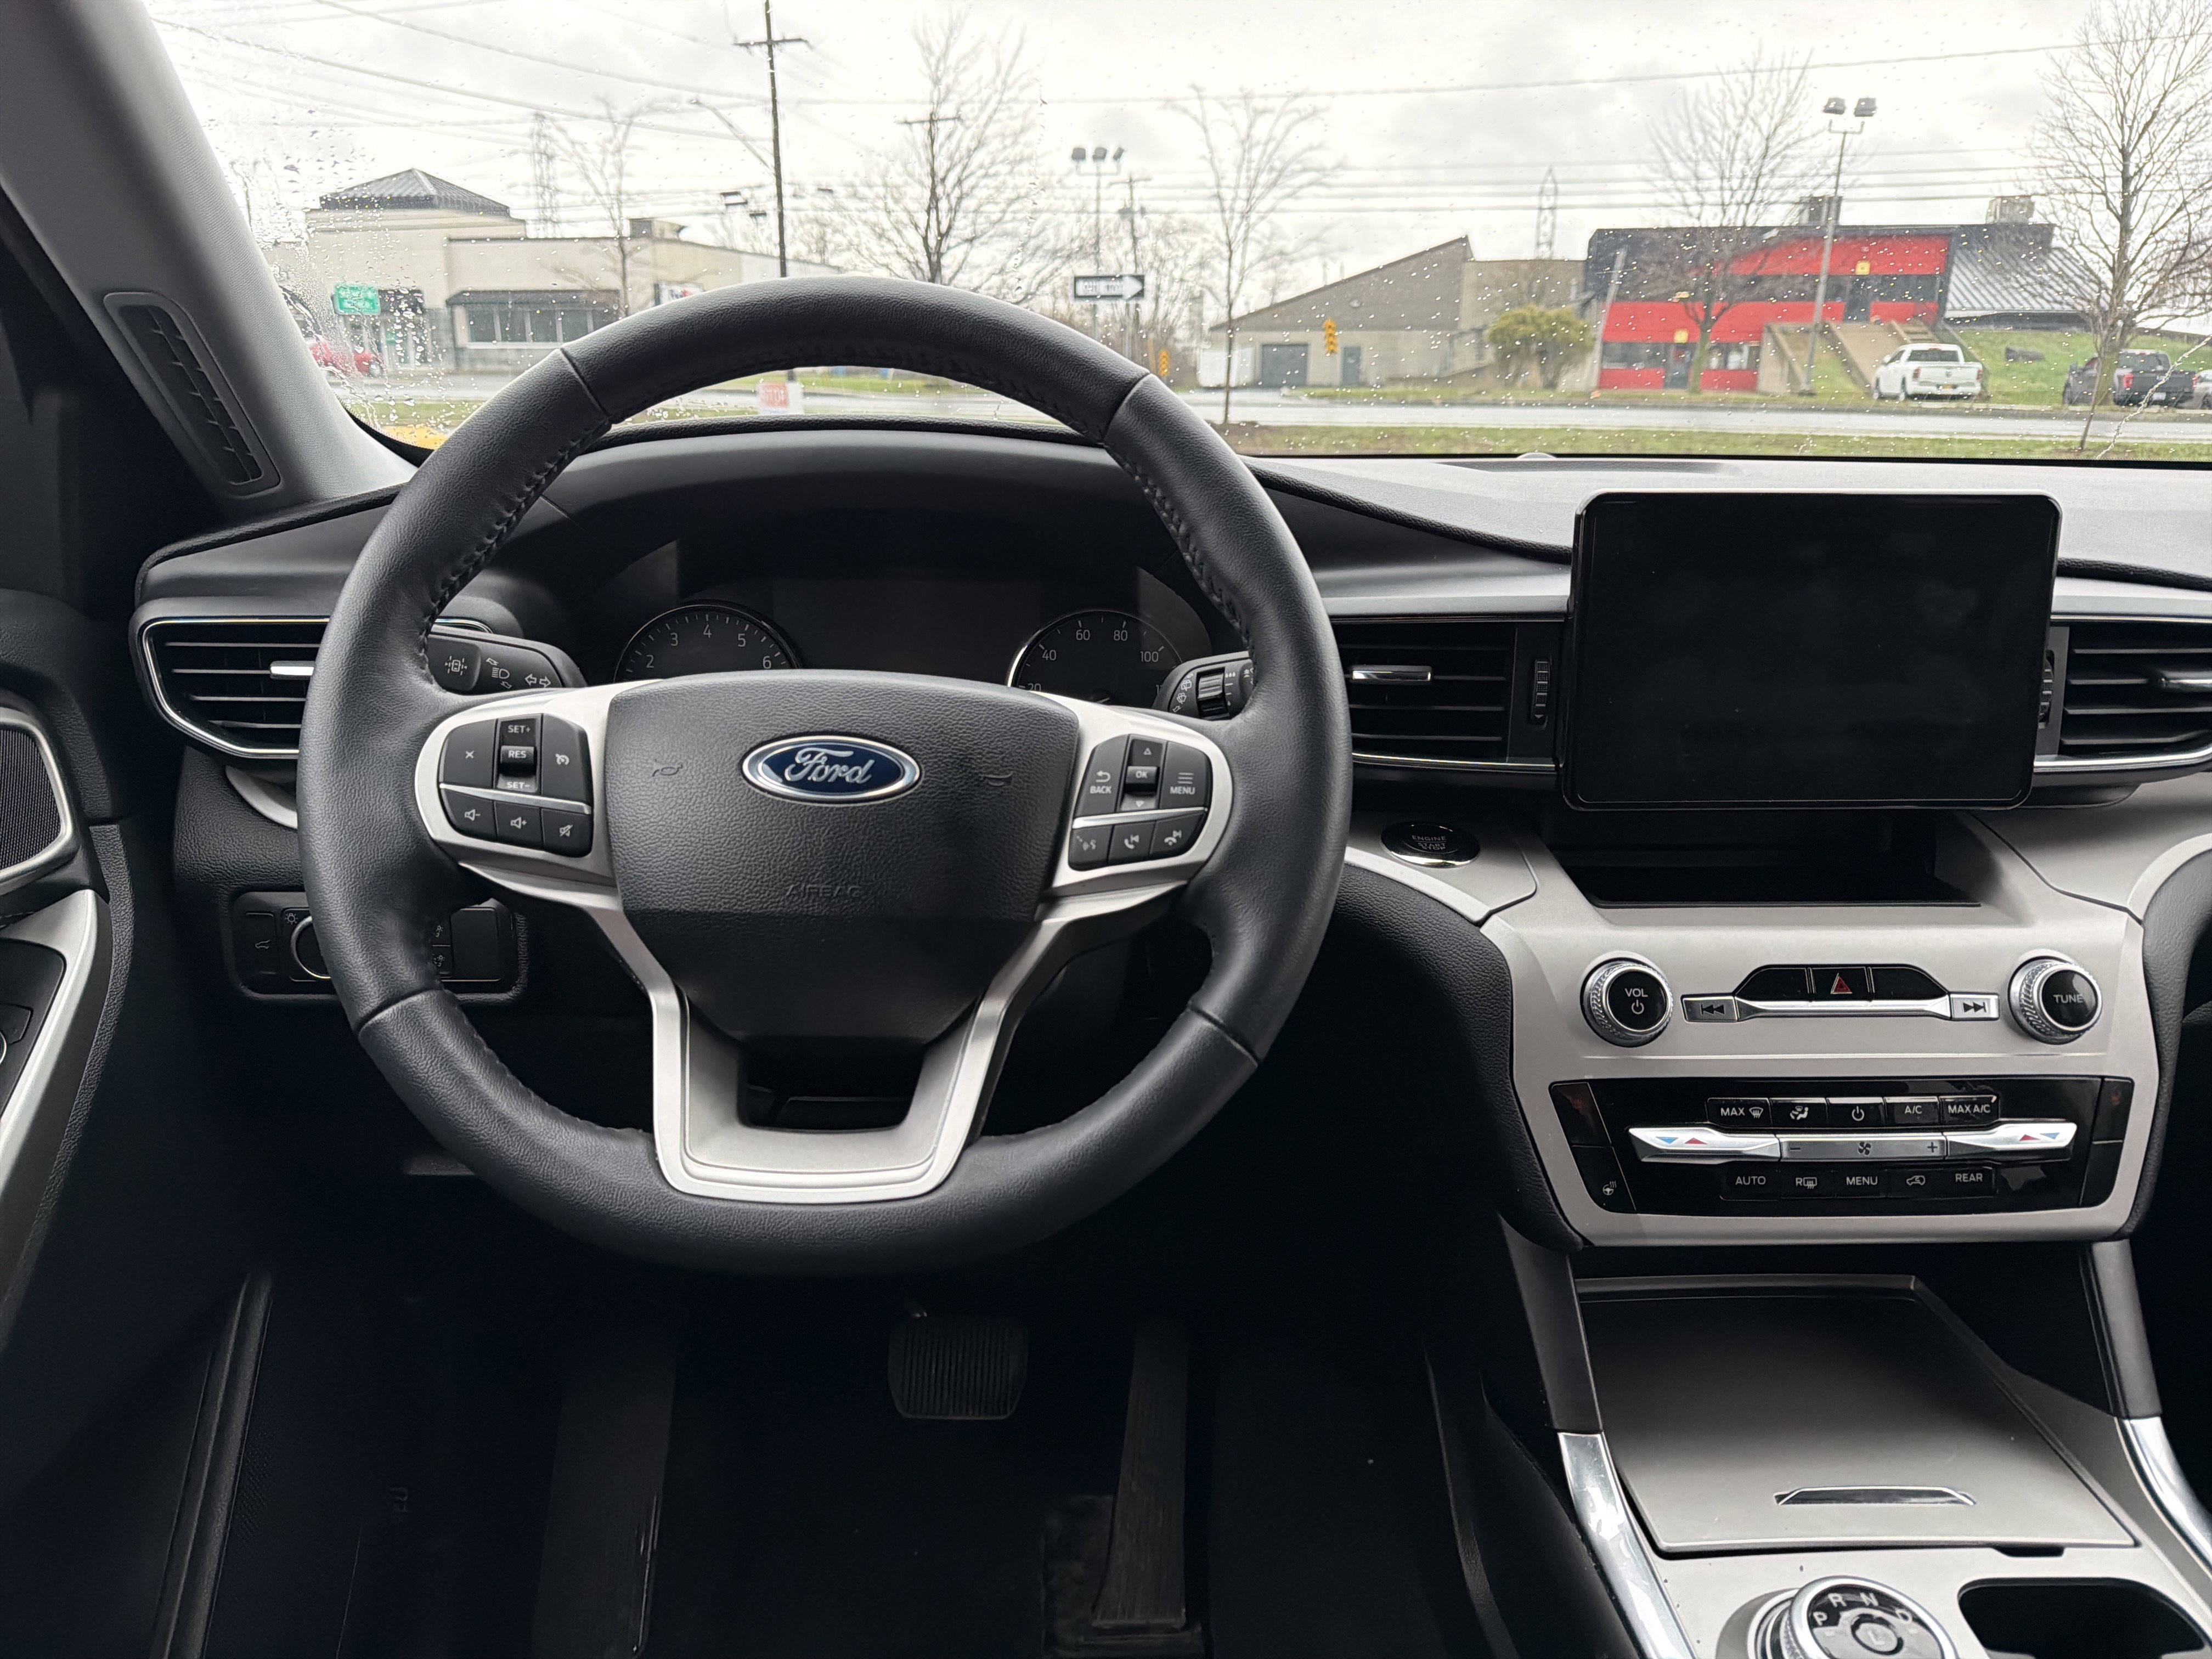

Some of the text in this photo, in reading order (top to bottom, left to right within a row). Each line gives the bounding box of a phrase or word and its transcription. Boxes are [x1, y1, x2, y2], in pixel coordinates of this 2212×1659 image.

[703, 624, 712, 638] 4
[1076, 629, 1091, 641] 60
[1113, 630, 1128, 641] 80
[670, 632, 679, 646] 3
[738, 633, 746, 647] 5
[1042, 649, 1057, 661] 40
[1140, 651, 1159, 663] 100
[646, 654, 654, 668] 2
[763, 656, 772, 669] 6
[508, 725, 531, 733] SET+
[508, 751, 527, 759] RES
[785, 747, 875, 785] Ford
[1135, 770, 1148, 779] OK
[1090, 785, 1112, 794] BACK
[1170, 786, 1195, 795] MENU
[1624, 988, 1649, 997] VOL
[2053, 994, 2084, 1003] TUNE
[1720, 1107, 1745, 1116] MAX
[1904, 1105, 1922, 1114] A/C
[1948, 1104, 1991, 1114] MAX A/C
[1735, 1176, 1766, 1185] AUTO
[1846, 1176, 1878, 1186] MENU
[1955, 1173, 1983, 1182] REAR
[1828, 1593, 1847, 1607] R
[1860, 1592, 1879, 1607] N
[1813, 1611, 1828, 1626] P
[1895, 1609, 1913, 1625] D
[1867, 1630, 1885, 1646] L
